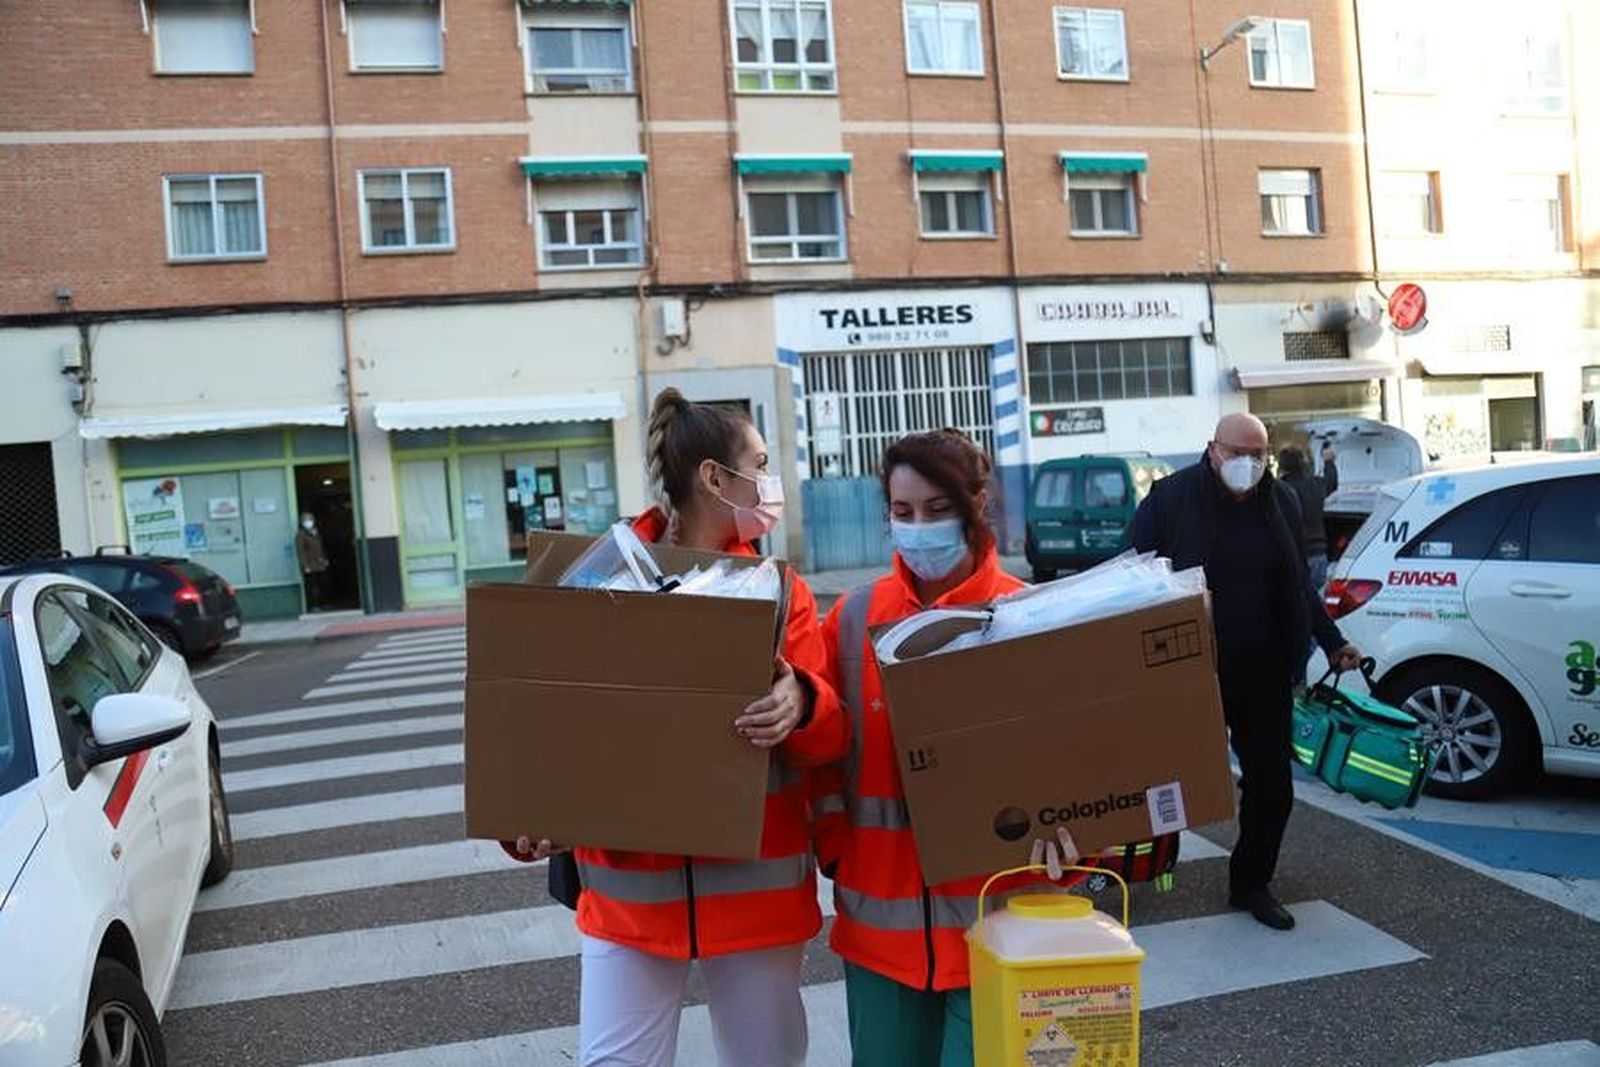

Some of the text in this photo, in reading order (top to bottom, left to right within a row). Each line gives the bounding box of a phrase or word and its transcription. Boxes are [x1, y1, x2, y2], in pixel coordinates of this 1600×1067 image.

[820, 305, 973, 328] TALLERES
[1384, 521, 1409, 543] M
[1388, 570, 1459, 587] EMASA
